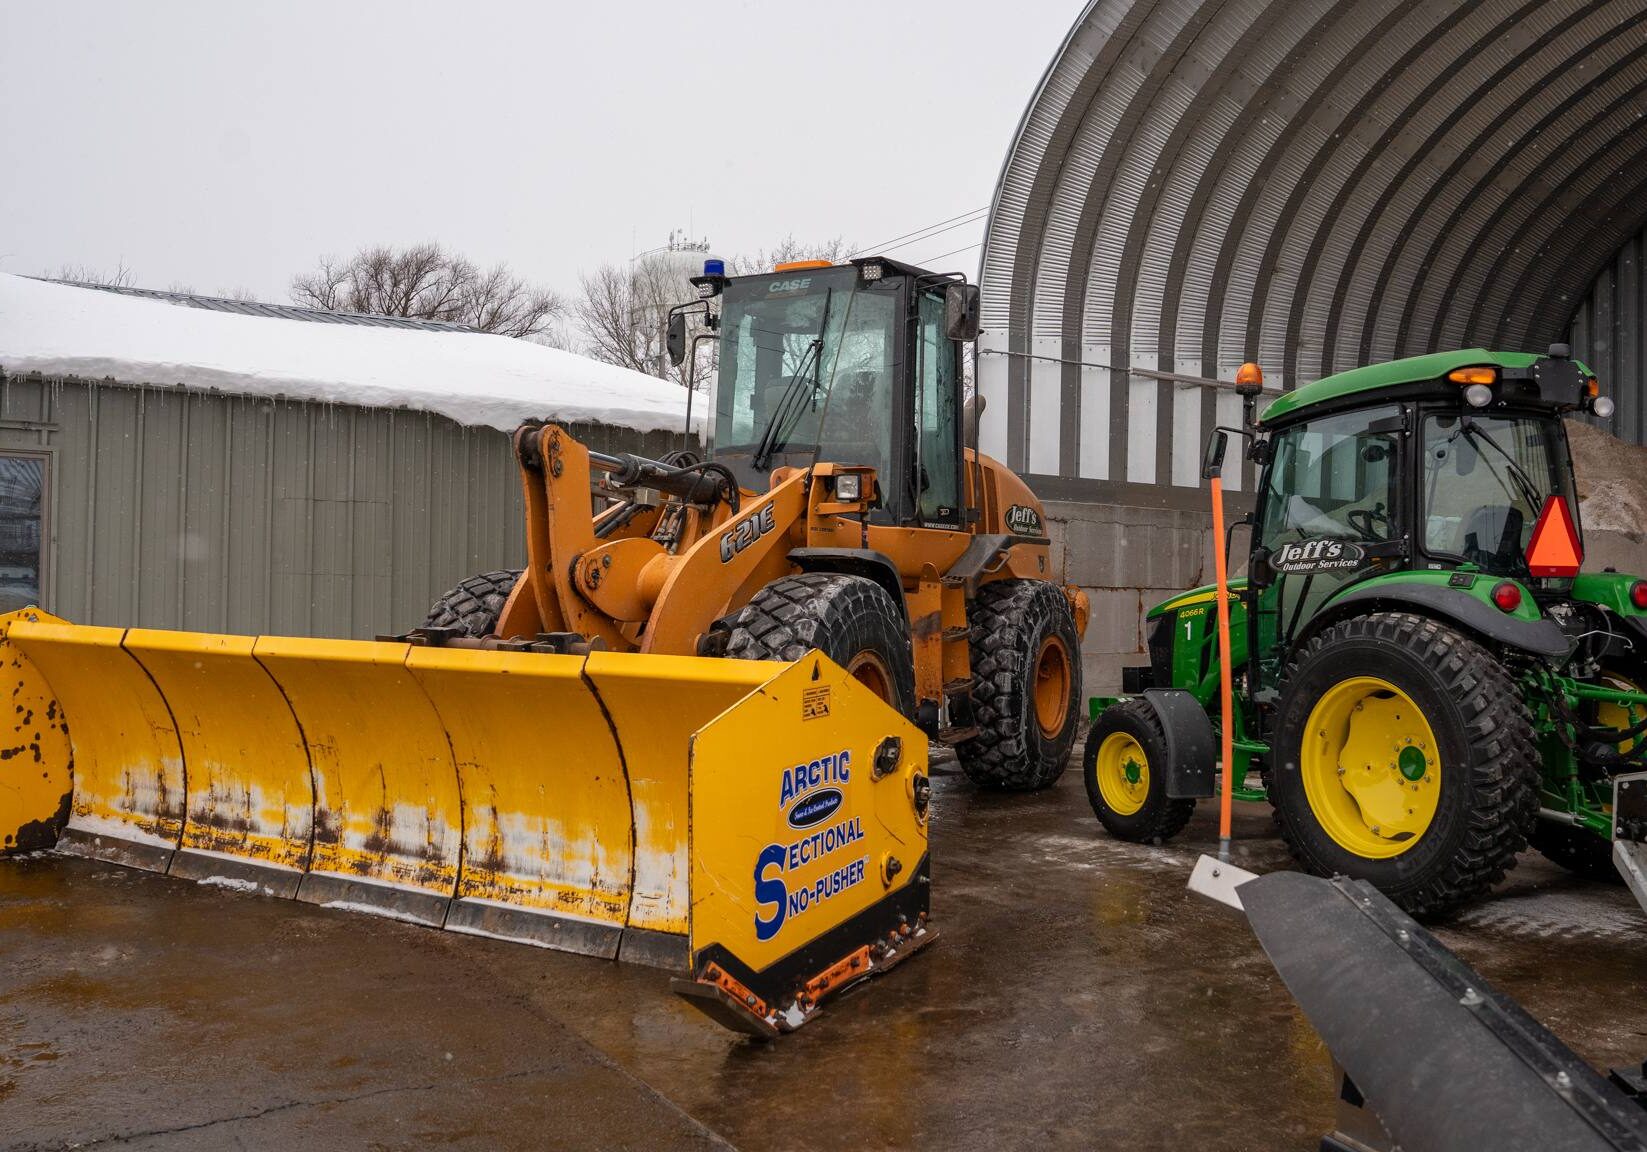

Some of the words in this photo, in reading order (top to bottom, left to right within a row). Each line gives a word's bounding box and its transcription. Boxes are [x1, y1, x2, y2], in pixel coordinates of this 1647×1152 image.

[769, 278, 811, 292] CASE
[1010, 505, 1037, 524] Jeff's
[720, 500, 776, 564] 621E
[1277, 539, 1342, 564] Jeff's
[1283, 561, 1316, 571] Outdoor
[1318, 558, 1359, 569] Services
[1180, 607, 1205, 618] 4066R
[1184, 621, 1192, 641] 1
[779, 749, 851, 810] ARCTIC
